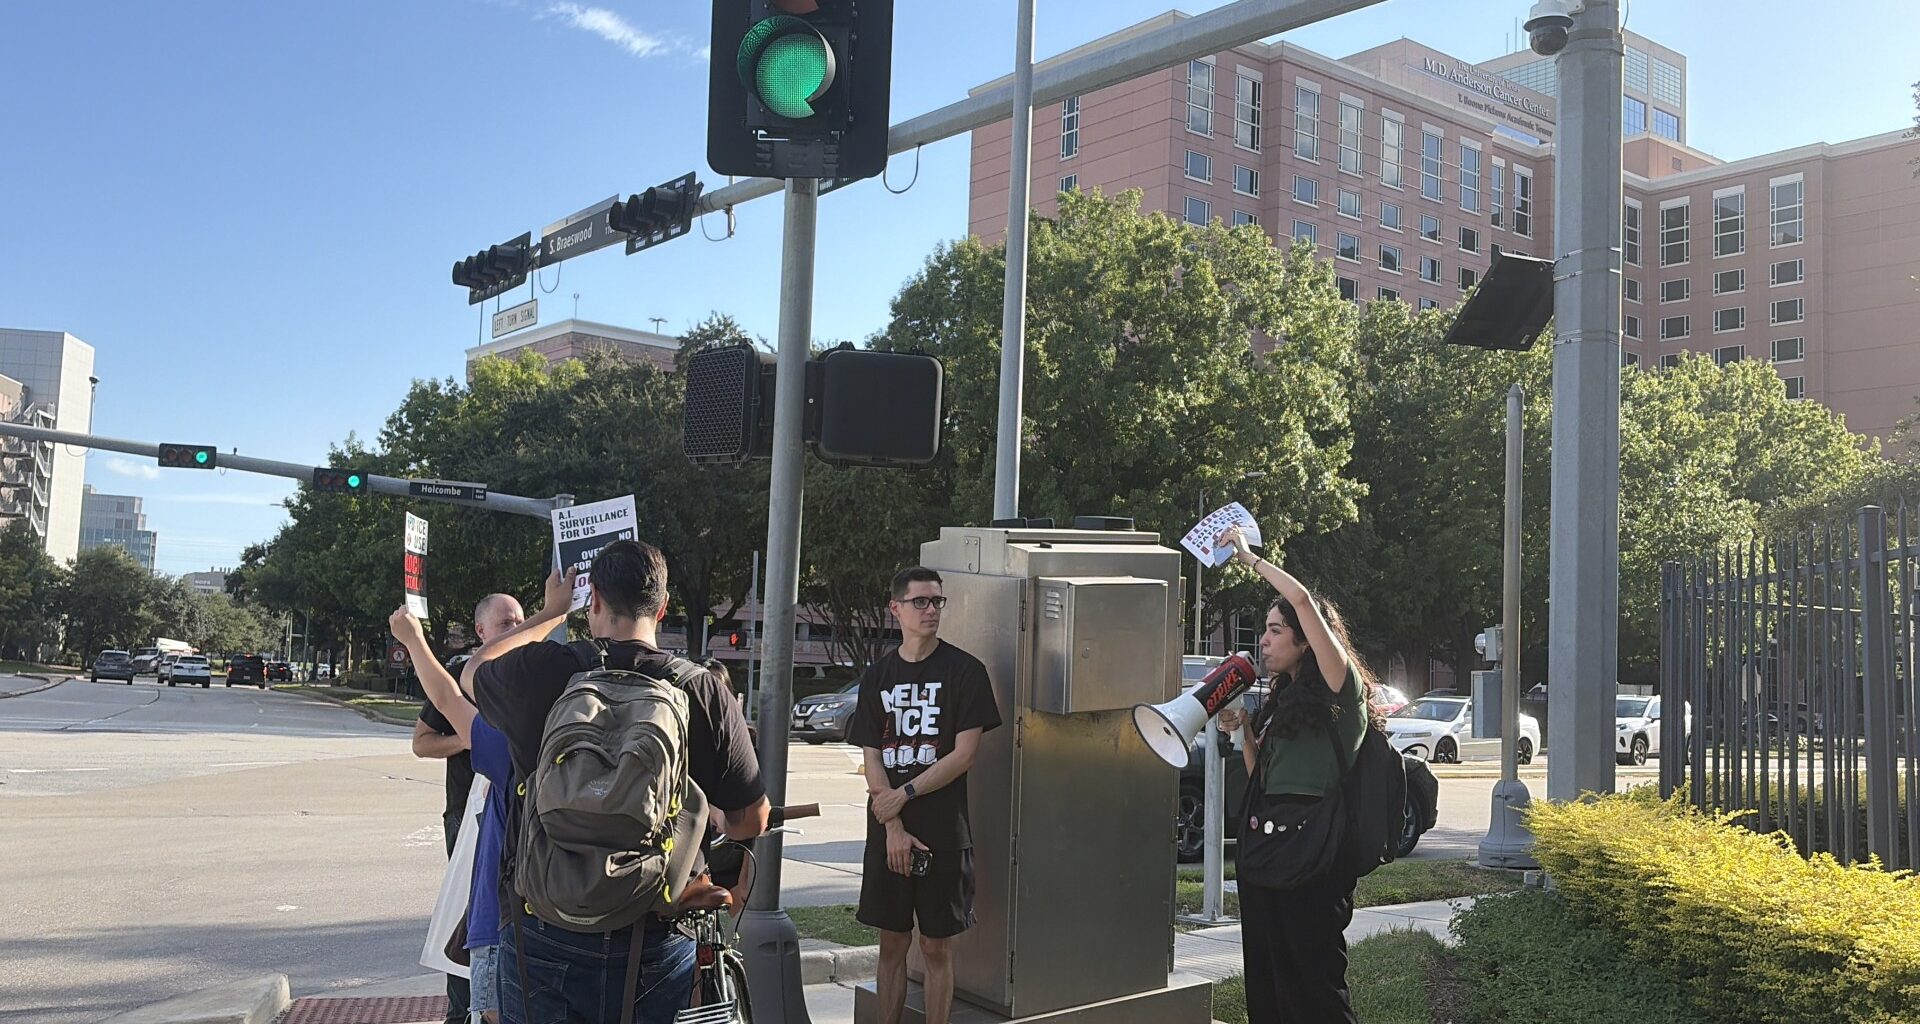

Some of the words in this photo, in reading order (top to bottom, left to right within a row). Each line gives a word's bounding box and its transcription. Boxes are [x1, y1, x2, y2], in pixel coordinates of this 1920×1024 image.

[1424, 57, 1449, 78] M.D.
[1449, 69, 1492, 95] Anderson
[1492, 85, 1521, 106] Cancer
[1522, 96, 1551, 117] Center
[549, 239, 556, 255] S.
[556, 222, 593, 251] Braeswood
[421, 484, 462, 496] Holcombe
[558, 510, 574, 521] A.I.
[559, 508, 629, 530] SURVEILLANCE
[1186, 504, 1237, 541] FLOCK
[561, 529, 580, 540] FOR
[583, 526, 596, 536] US
[618, 530, 632, 541] NO
[581, 547, 604, 560] OVE
[573, 560, 592, 571] FOR
[880, 682, 942, 713] MELT
[892, 700, 940, 737] ICE
